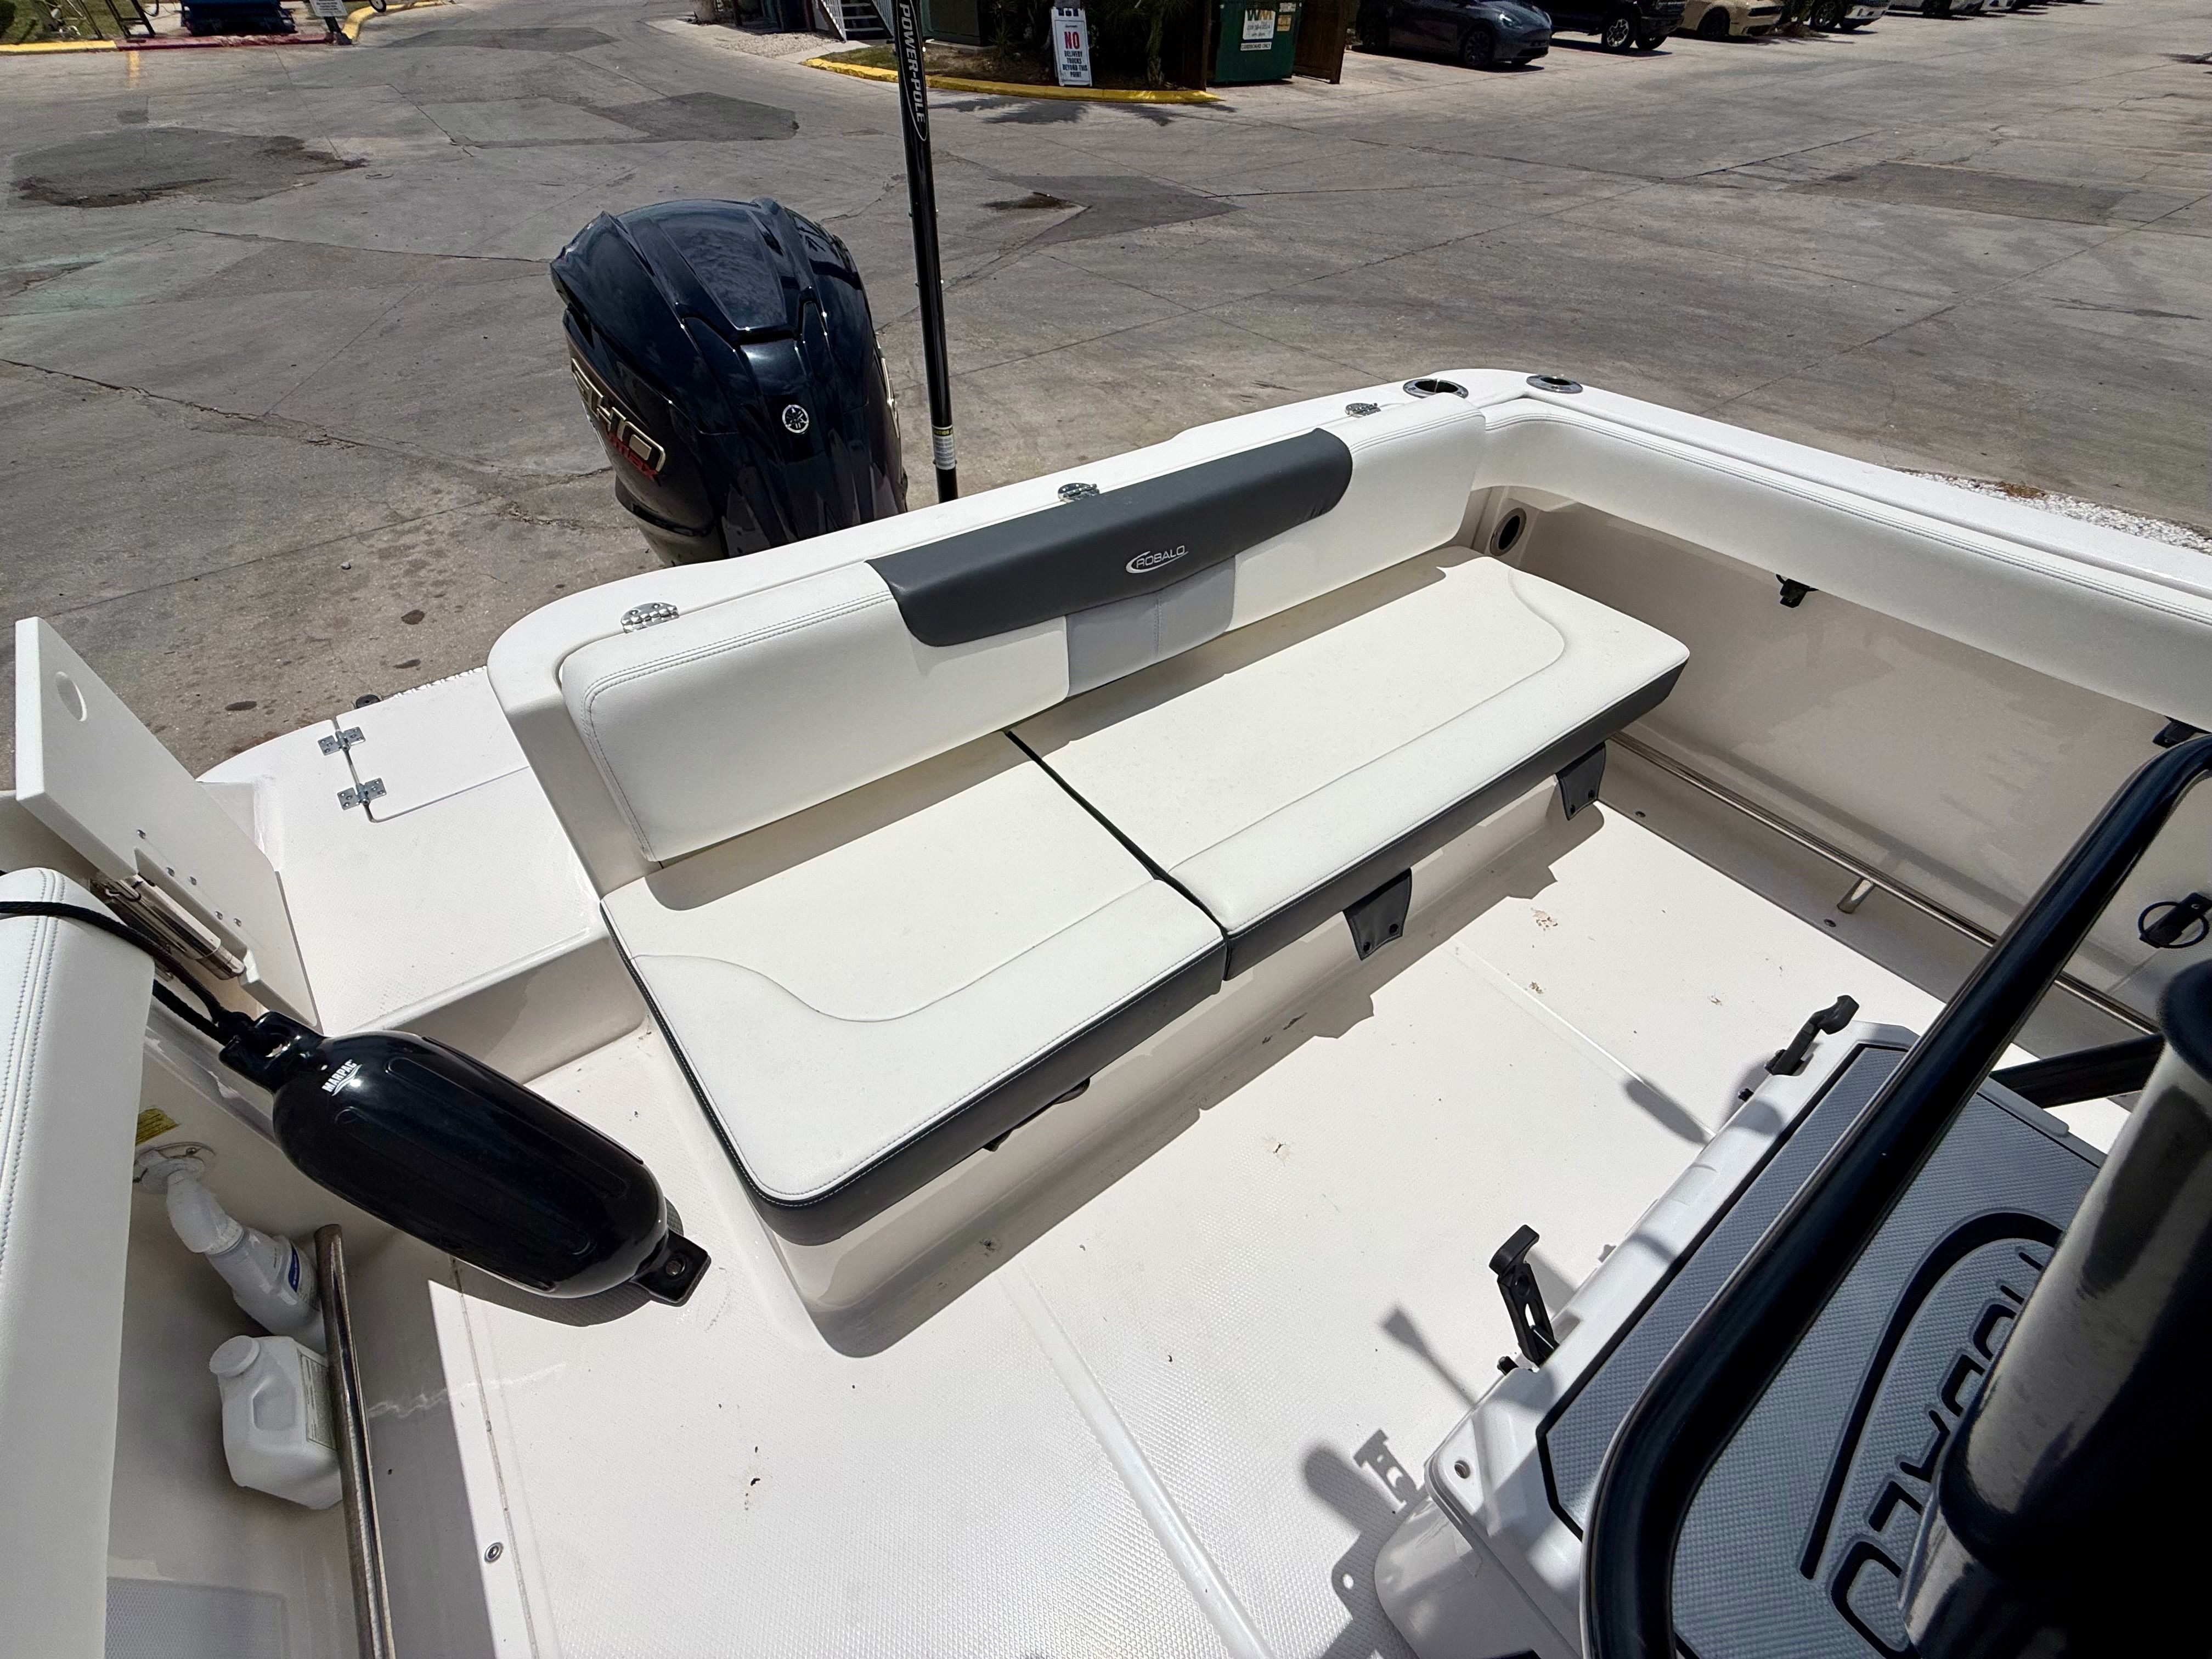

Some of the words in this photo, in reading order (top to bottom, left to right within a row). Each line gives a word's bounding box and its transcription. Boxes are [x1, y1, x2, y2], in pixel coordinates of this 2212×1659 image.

[1064, 31, 1080, 49] NO
[899, 3, 926, 123] POWER-POLE
[1136, 545, 1185, 568] ROBALO
[321, 1059, 357, 1093] MARPAC
